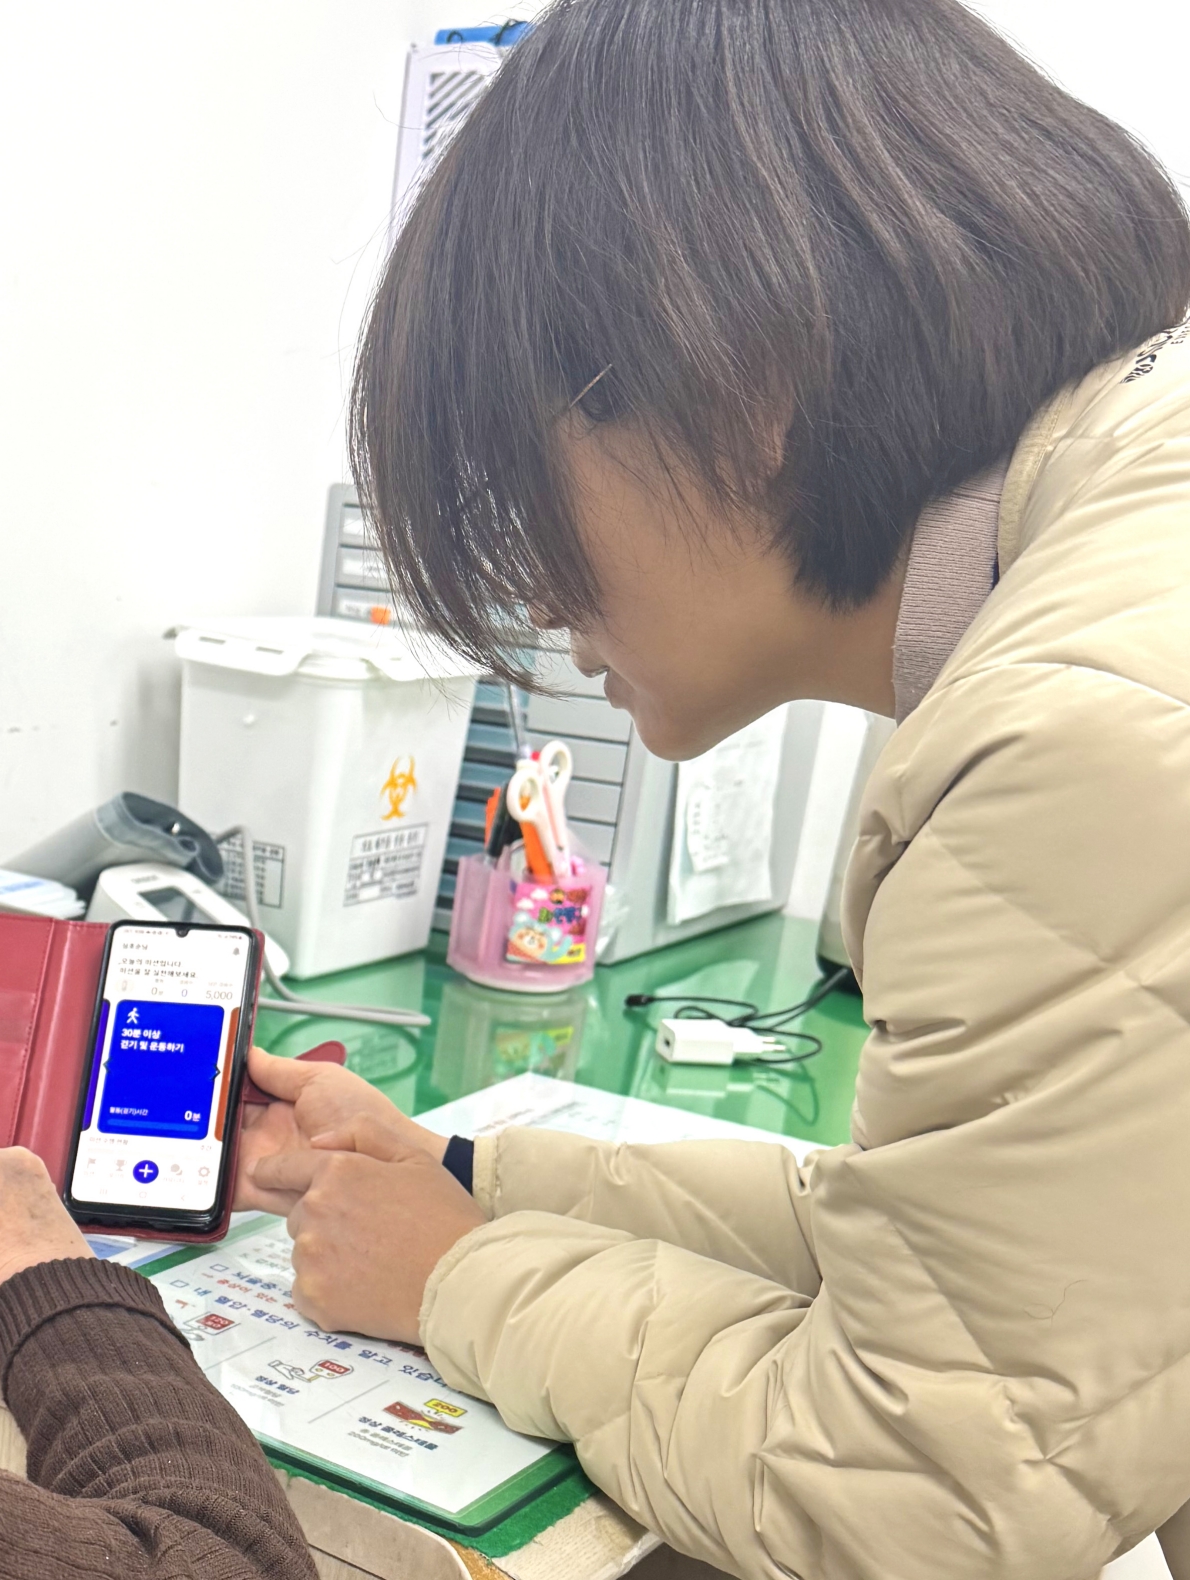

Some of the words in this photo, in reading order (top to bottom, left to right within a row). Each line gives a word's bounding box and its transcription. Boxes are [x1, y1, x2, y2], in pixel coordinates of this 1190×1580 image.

[181, 988, 188, 998] 0
[205, 990, 233, 1001] 5,000
[121, 1028, 142, 1038] 30분
[143, 1029, 161, 1040] 이상
[120, 1039, 137, 1050] 걷기
[139, 1040, 148, 1051] 및
[149, 1041, 185, 1053] 운동하기
[184, 1110, 201, 1122] 0분
[194, 1287, 212, 1297] 내
[304, 1330, 353, 1350] 수치를
[358, 1349, 394, 1367] 알고
[398, 1364, 447, 1388] 있습니
[324, 1362, 345, 1373] 100
[433, 1401, 458, 1414] 200
[381, 1425, 439, 1451] 콜레스테롤
